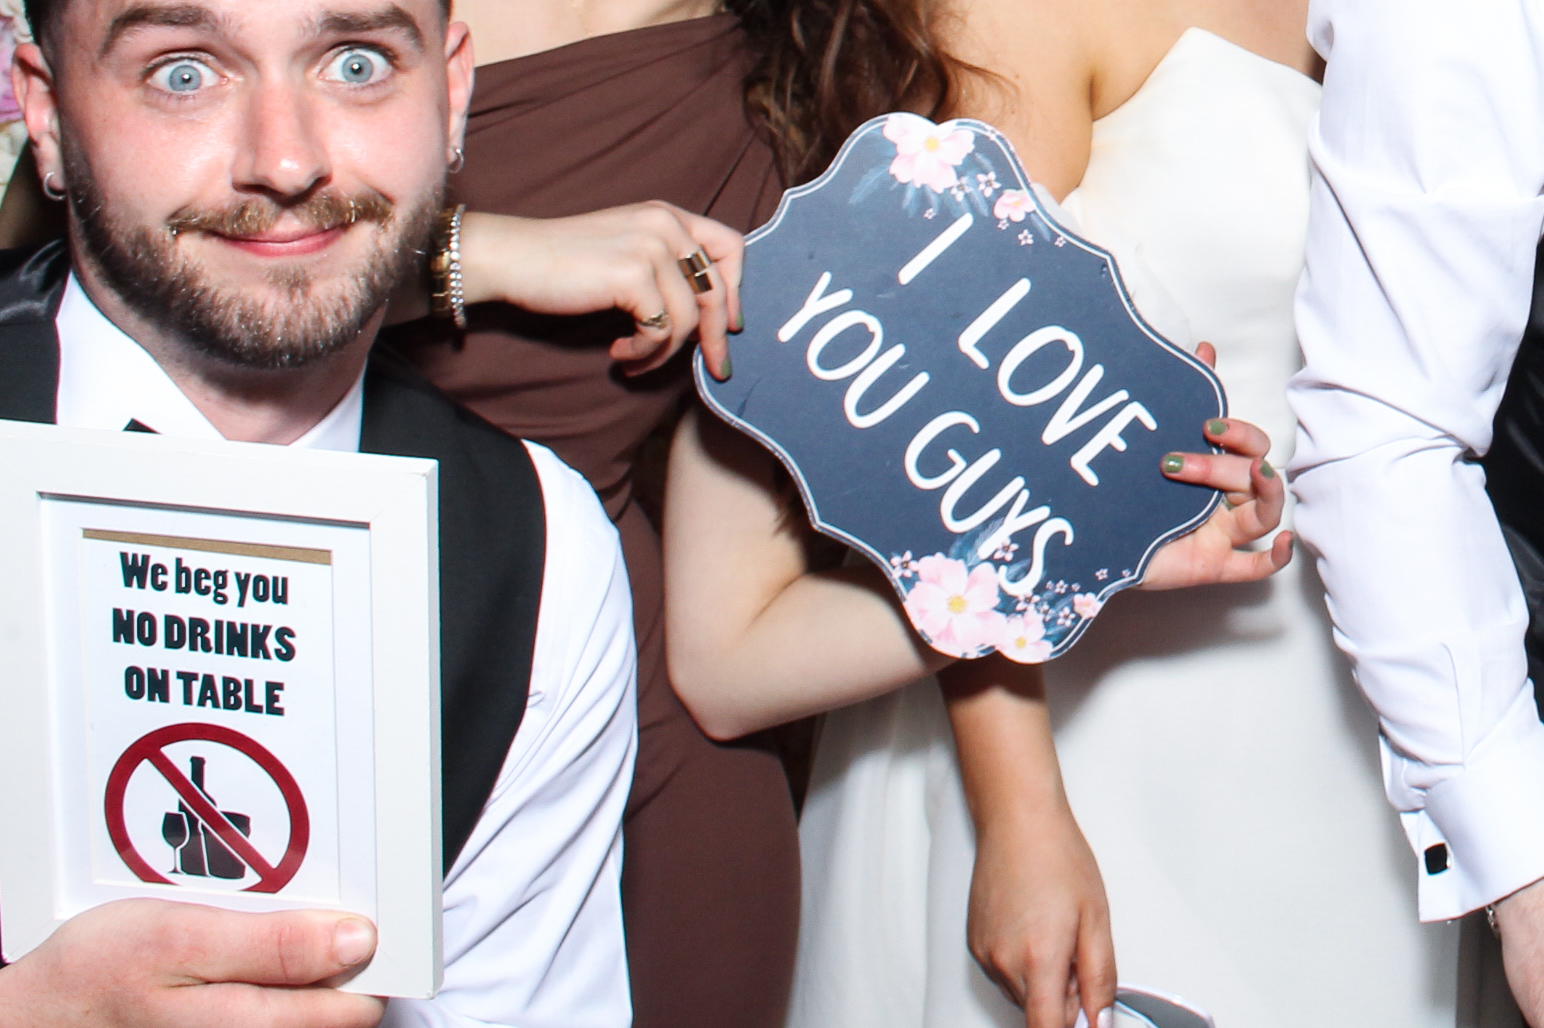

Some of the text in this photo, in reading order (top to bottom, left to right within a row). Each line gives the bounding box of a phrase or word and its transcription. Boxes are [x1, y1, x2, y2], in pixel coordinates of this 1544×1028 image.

[898, 212, 1158, 487] I LOVE
[777, 271, 1075, 597] YOU GUYS
[119, 551, 288, 608] We beg you
[112, 607, 297, 662] NO DRINKS
[124, 665, 286, 717] ON TABLE
